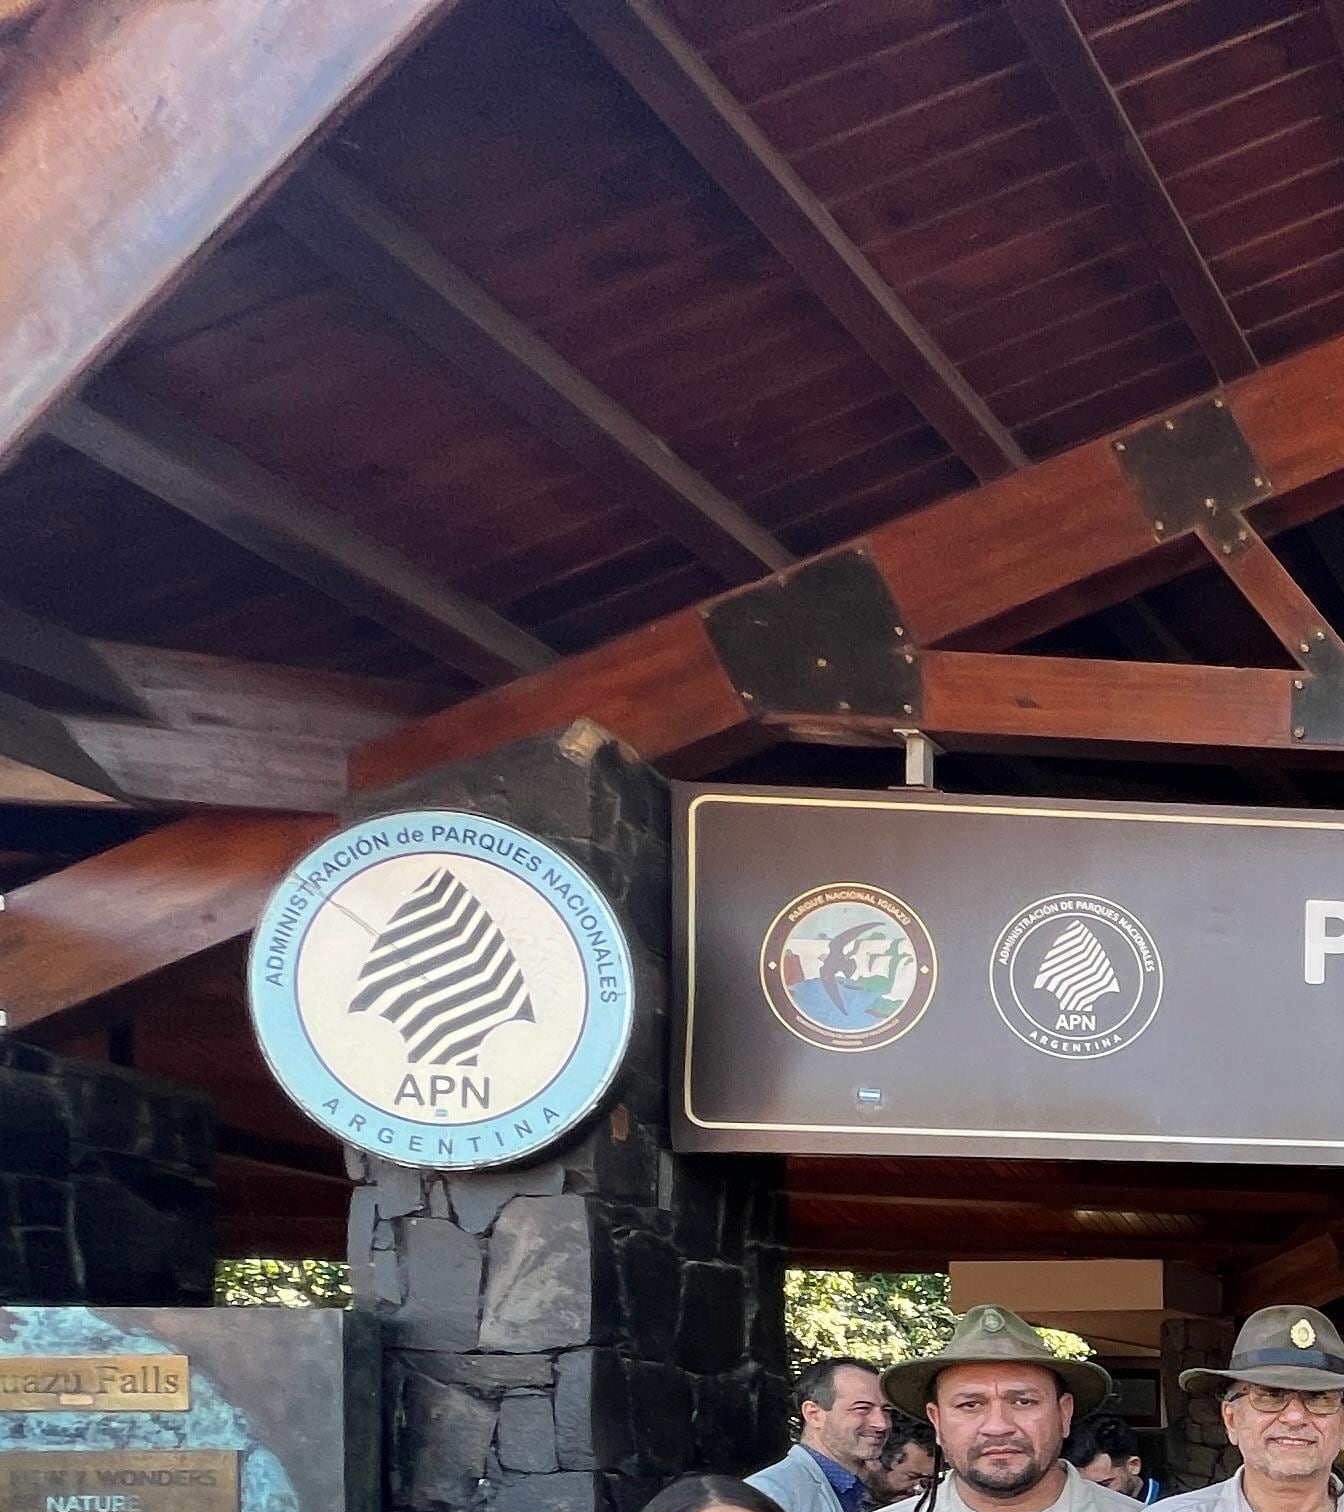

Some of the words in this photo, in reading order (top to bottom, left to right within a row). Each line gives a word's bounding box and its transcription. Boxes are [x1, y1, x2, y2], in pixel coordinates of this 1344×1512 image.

[265, 831, 390, 988] ADMINISTRACIÓN
[397, 827, 424, 845] de
[432, 825, 543, 871] PARQUES
[543, 867, 619, 1004] NACIONALES
[788, 895, 824, 922] PARQUE
[825, 891, 876, 905] NACIONAL
[1061, 900, 1074, 911] DE
[1075, 901, 1120, 921] PARQUES
[1118, 917, 1155, 973] NACIONALES
[1055, 1014, 1097, 1032] APN
[1029, 1030, 1123, 1053] ARGENTINA
[394, 1073, 491, 1109] APN
[322, 1096, 561, 1156] ARGENTINA
[95, 1365, 180, 1394] Falls
[97, 1469, 218, 1487] WONDERS
[46, 1495, 143, 1512] NATURE
